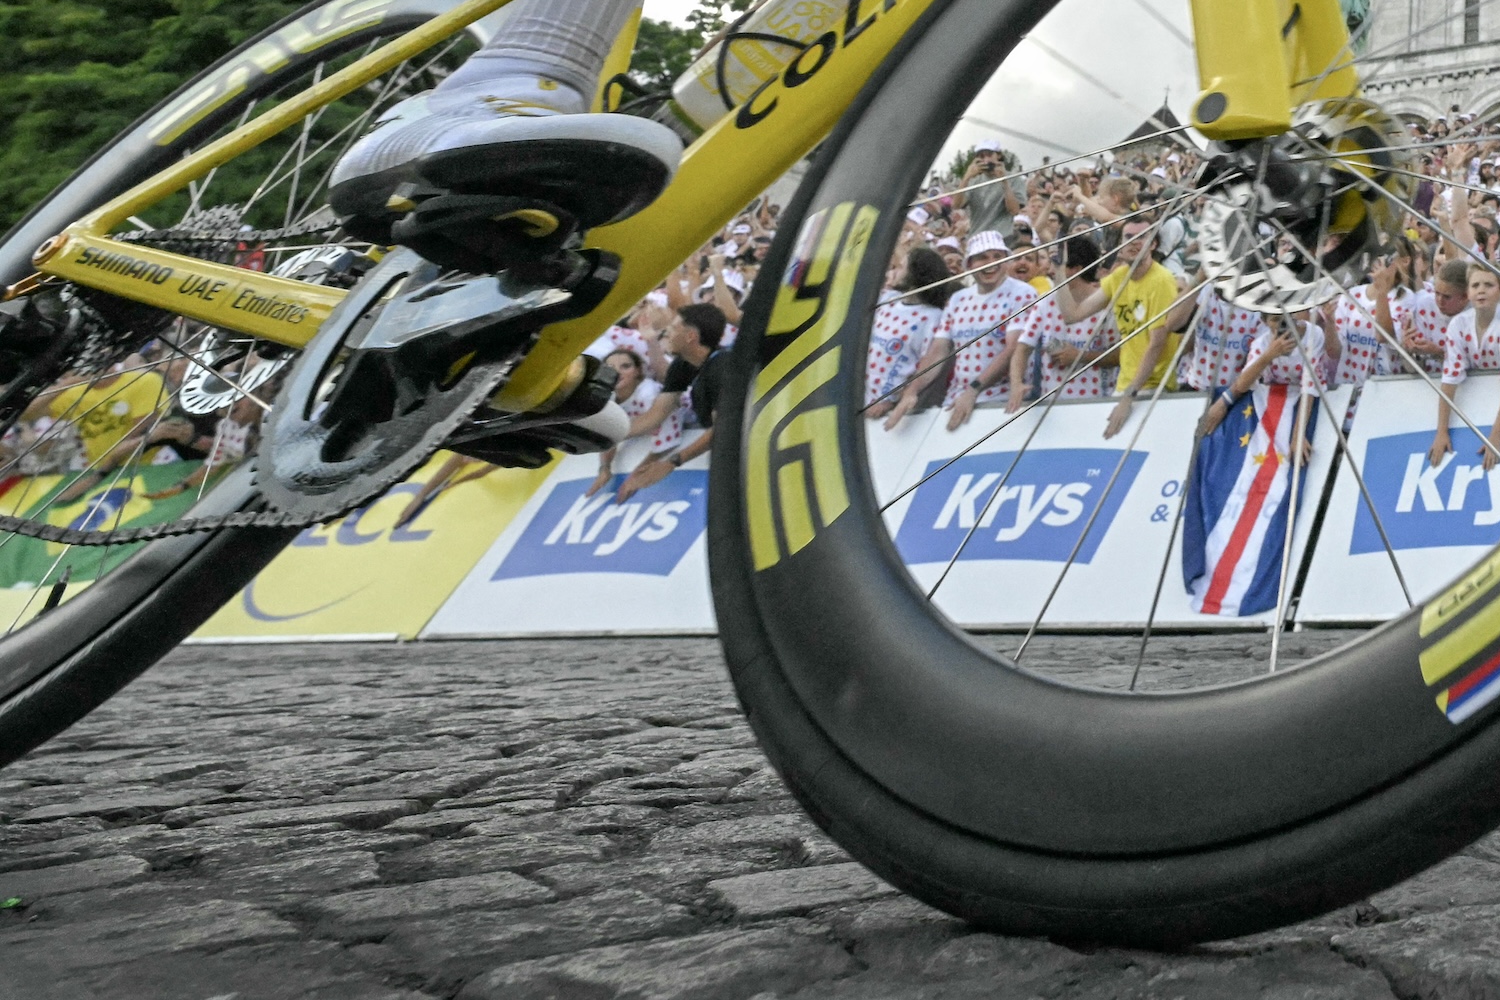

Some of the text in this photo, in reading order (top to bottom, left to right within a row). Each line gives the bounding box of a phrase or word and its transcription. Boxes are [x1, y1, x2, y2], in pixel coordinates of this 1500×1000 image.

[75, 246, 308, 324] SHIMANO UAE Emirates
[543, 491, 691, 556] Krys
[932, 472, 1094, 543] Krys
